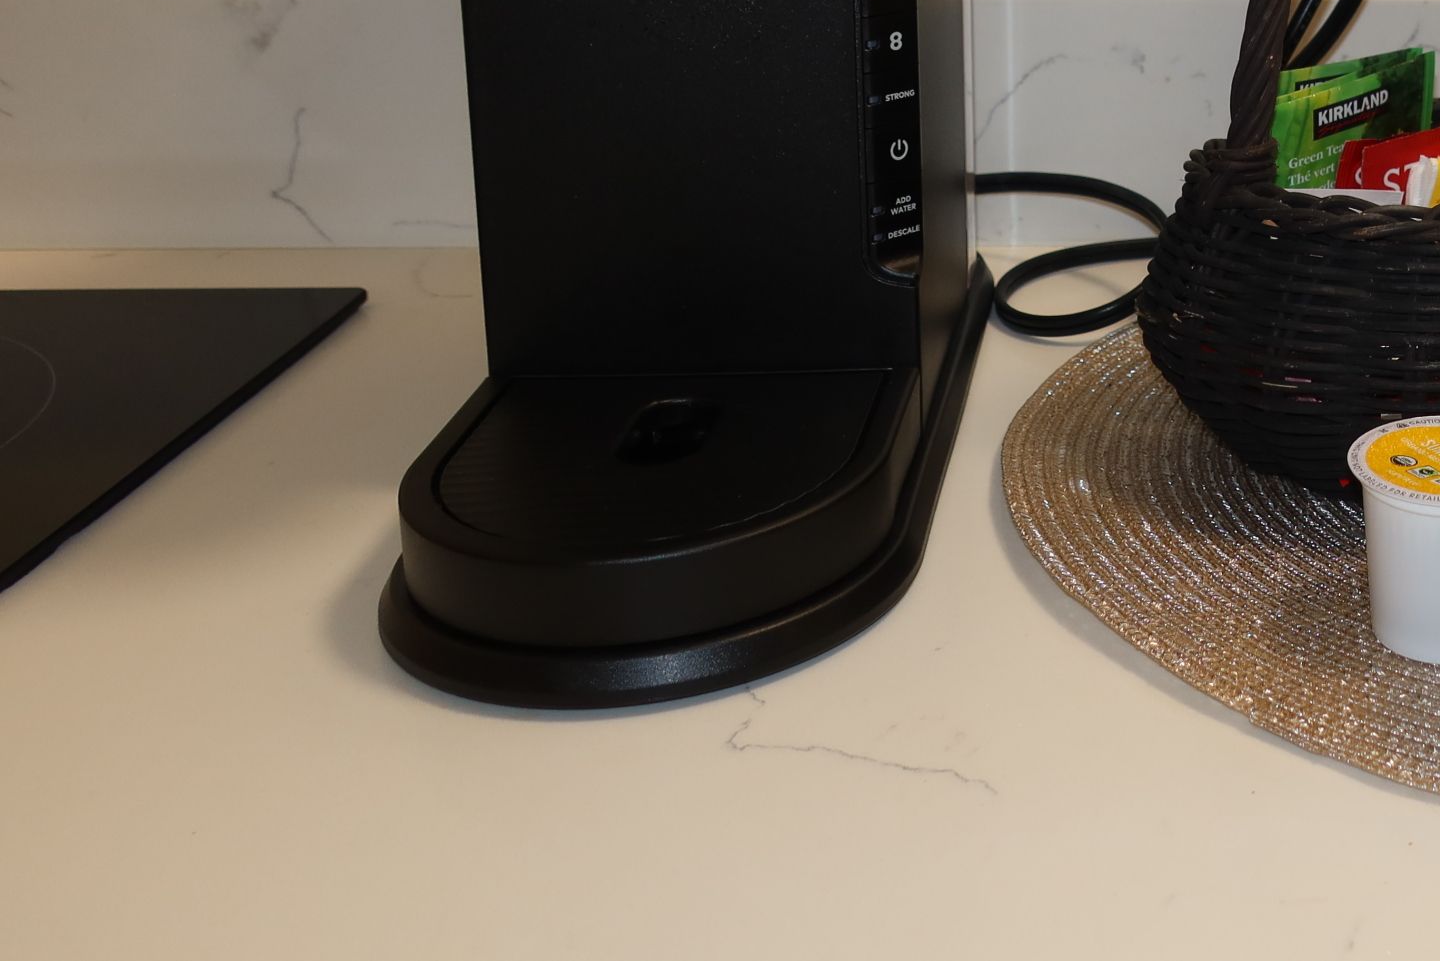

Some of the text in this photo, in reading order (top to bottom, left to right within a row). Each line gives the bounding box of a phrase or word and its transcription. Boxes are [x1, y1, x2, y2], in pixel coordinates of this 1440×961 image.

[889, 31, 903, 51] 8
[885, 89, 915, 102] STRONG
[1318, 89, 1389, 127] KIRKLAND
[1288, 144, 1344, 169] Green Tea
[1288, 171, 1311, 186] Thé
[1314, 163, 1335, 178] vert
[896, 195, 911, 205] ADD
[890, 203, 917, 215] WATER
[888, 224, 920, 239] DESCALE
